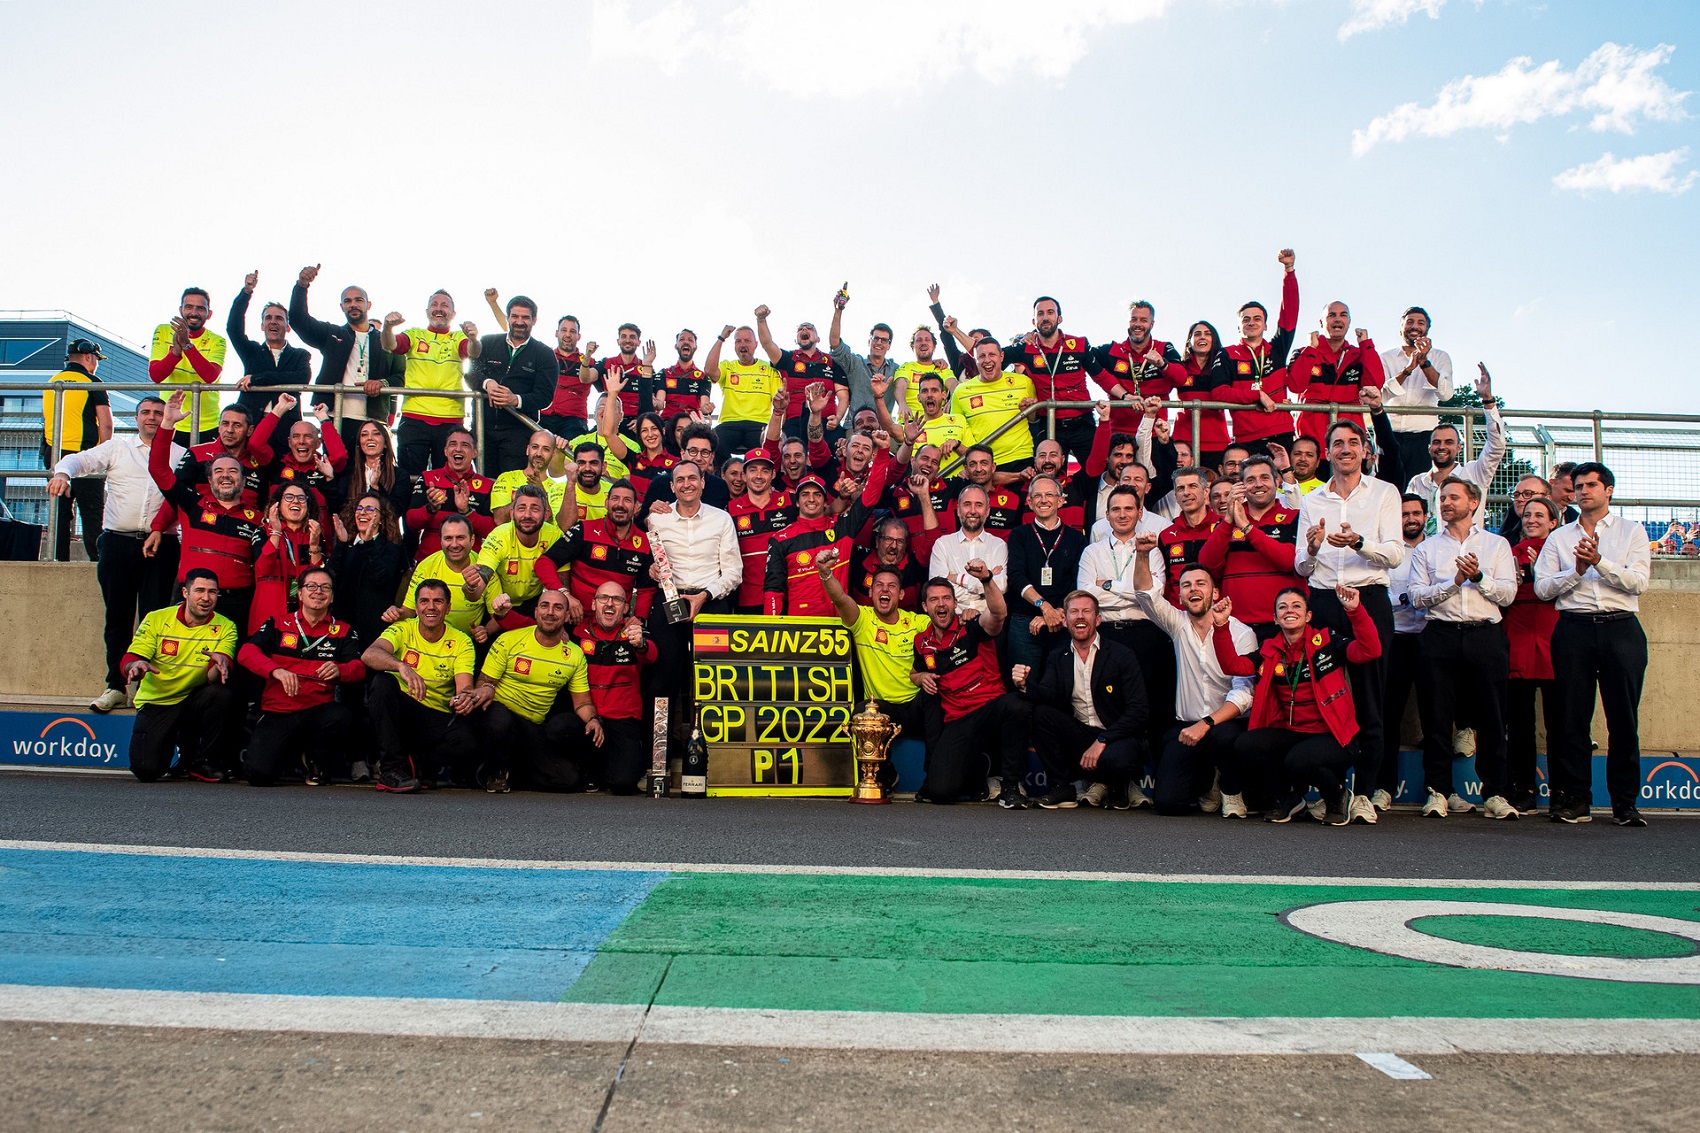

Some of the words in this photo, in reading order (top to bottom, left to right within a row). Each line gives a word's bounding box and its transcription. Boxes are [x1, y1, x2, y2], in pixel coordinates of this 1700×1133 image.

[694, 664, 853, 702] BRITISH
[700, 705, 746, 743] GP
[758, 706, 851, 743] 2022
[13, 736, 117, 763] workday
[1640, 780, 1700, 800] orkda
